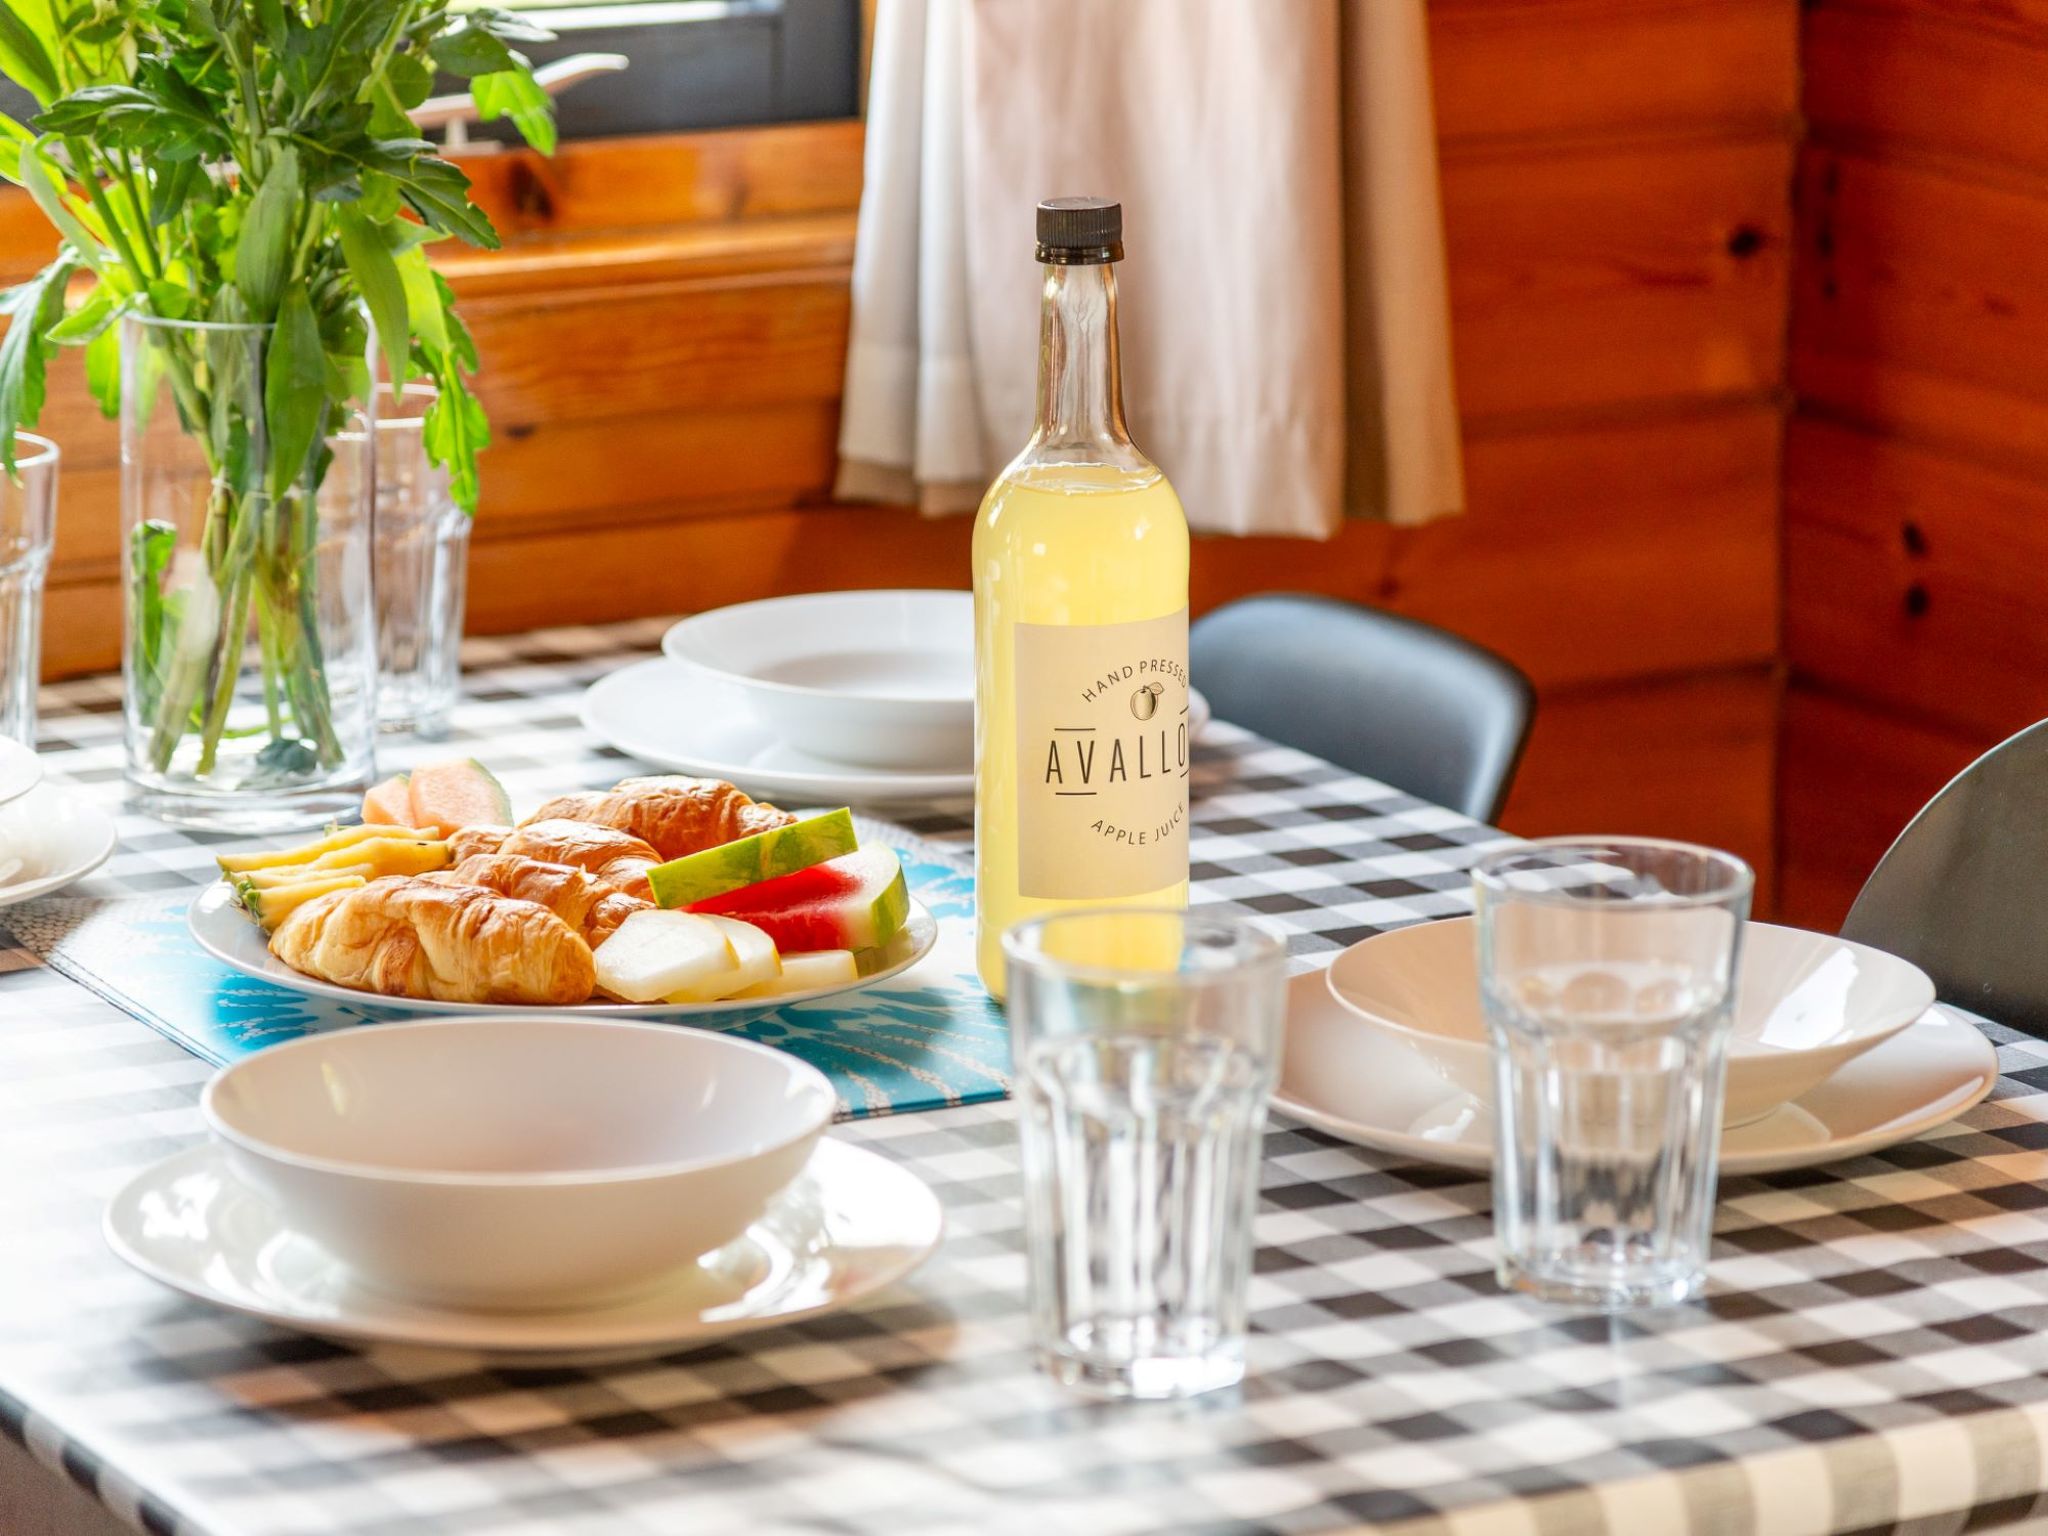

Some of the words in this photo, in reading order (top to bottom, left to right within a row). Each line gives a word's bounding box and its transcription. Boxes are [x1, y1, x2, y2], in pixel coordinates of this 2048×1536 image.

[1081, 665, 1133, 702] HAND
[1139, 659, 1187, 688] PRESSED
[1045, 723, 1187, 784] AVALLO
[1091, 819, 1146, 845] APPLE
[1155, 801, 1184, 841] JUICE
